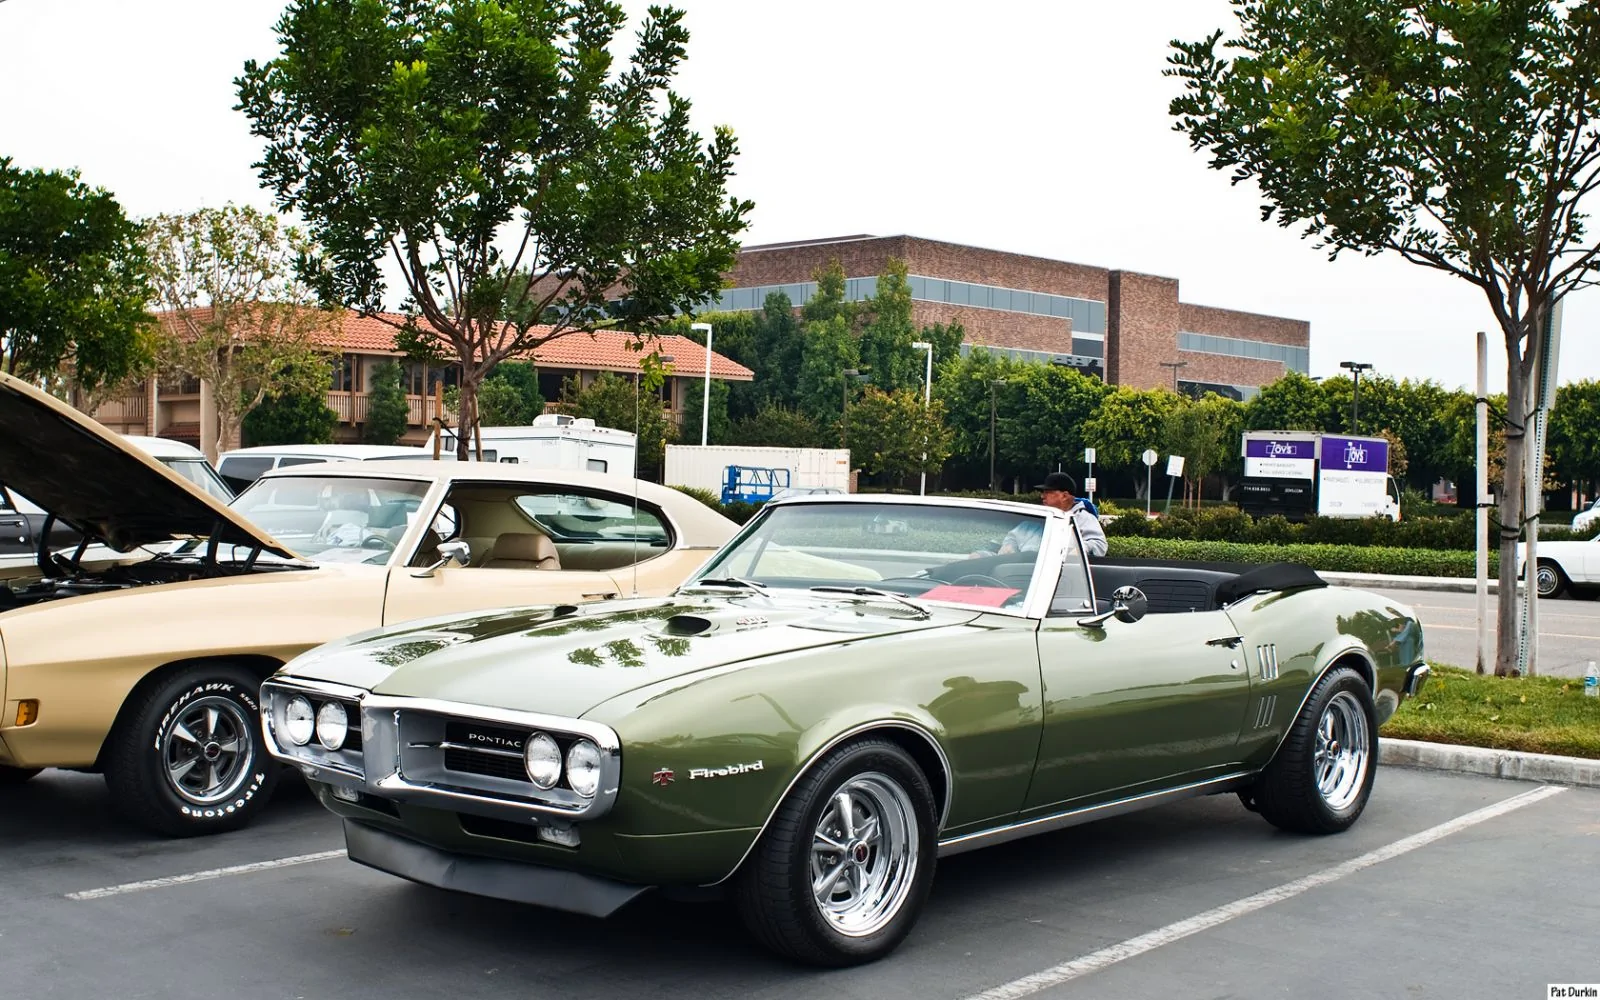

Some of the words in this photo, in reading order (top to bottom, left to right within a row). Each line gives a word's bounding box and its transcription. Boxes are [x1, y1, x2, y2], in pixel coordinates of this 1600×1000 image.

[154, 683, 235, 751] FIREHAWK
[468, 733, 521, 748] PONTIAC
[687, 760, 764, 780] Firebird
[181, 772, 265, 818] Firestone
